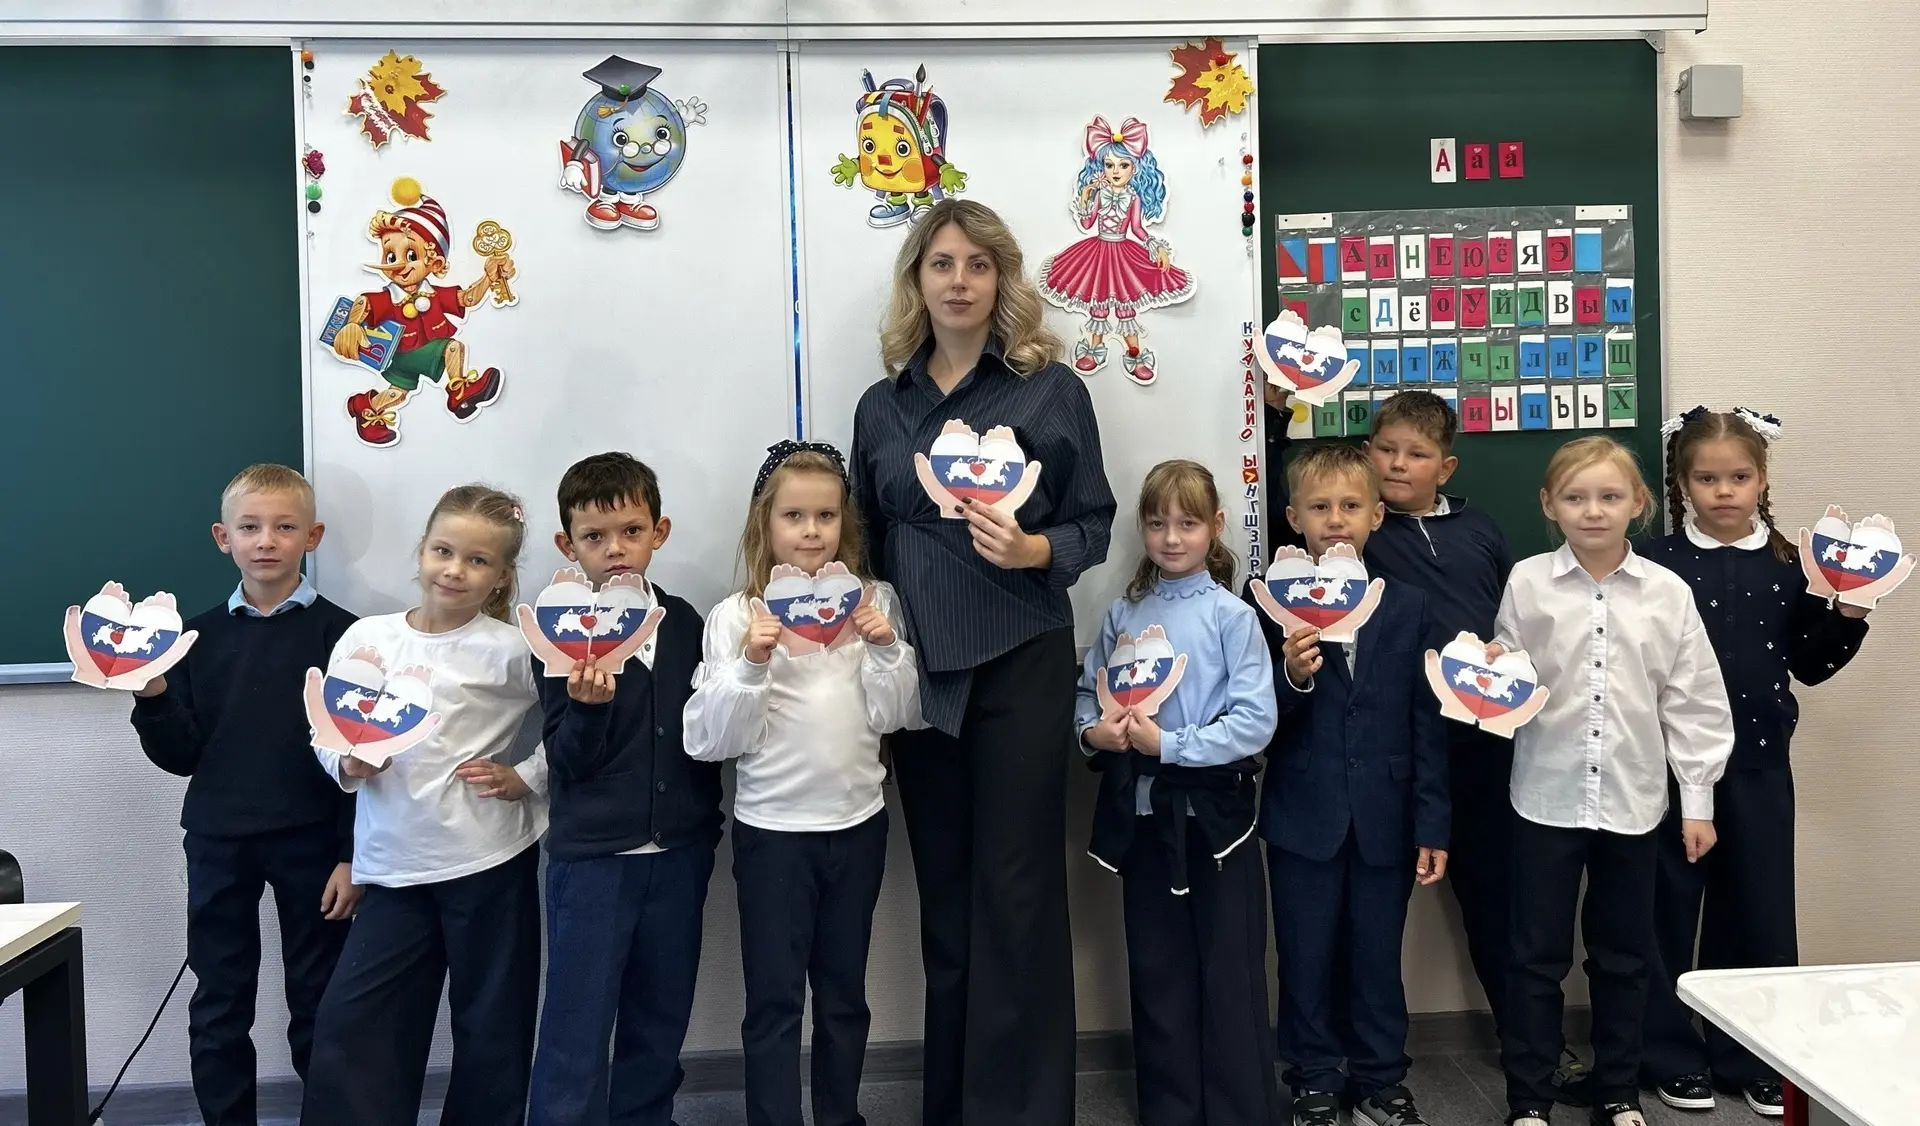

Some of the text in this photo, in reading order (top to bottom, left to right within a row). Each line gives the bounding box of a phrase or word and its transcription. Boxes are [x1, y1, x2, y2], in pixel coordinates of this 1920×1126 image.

[1436, 148, 1517, 172] А а а
[1345, 242, 1569, 269] А и Н Е Ю ё Я Э
[1375, 298, 1393, 327] Д
[1409, 302, 1421, 322] ё
[1523, 291, 1542, 317] Д
[1554, 294, 1569, 314] В
[1584, 342, 1598, 361] Р
[1495, 397, 1513, 421] Ы
[1554, 395, 1570, 419] Ъ
[1584, 394, 1598, 418] Ь
